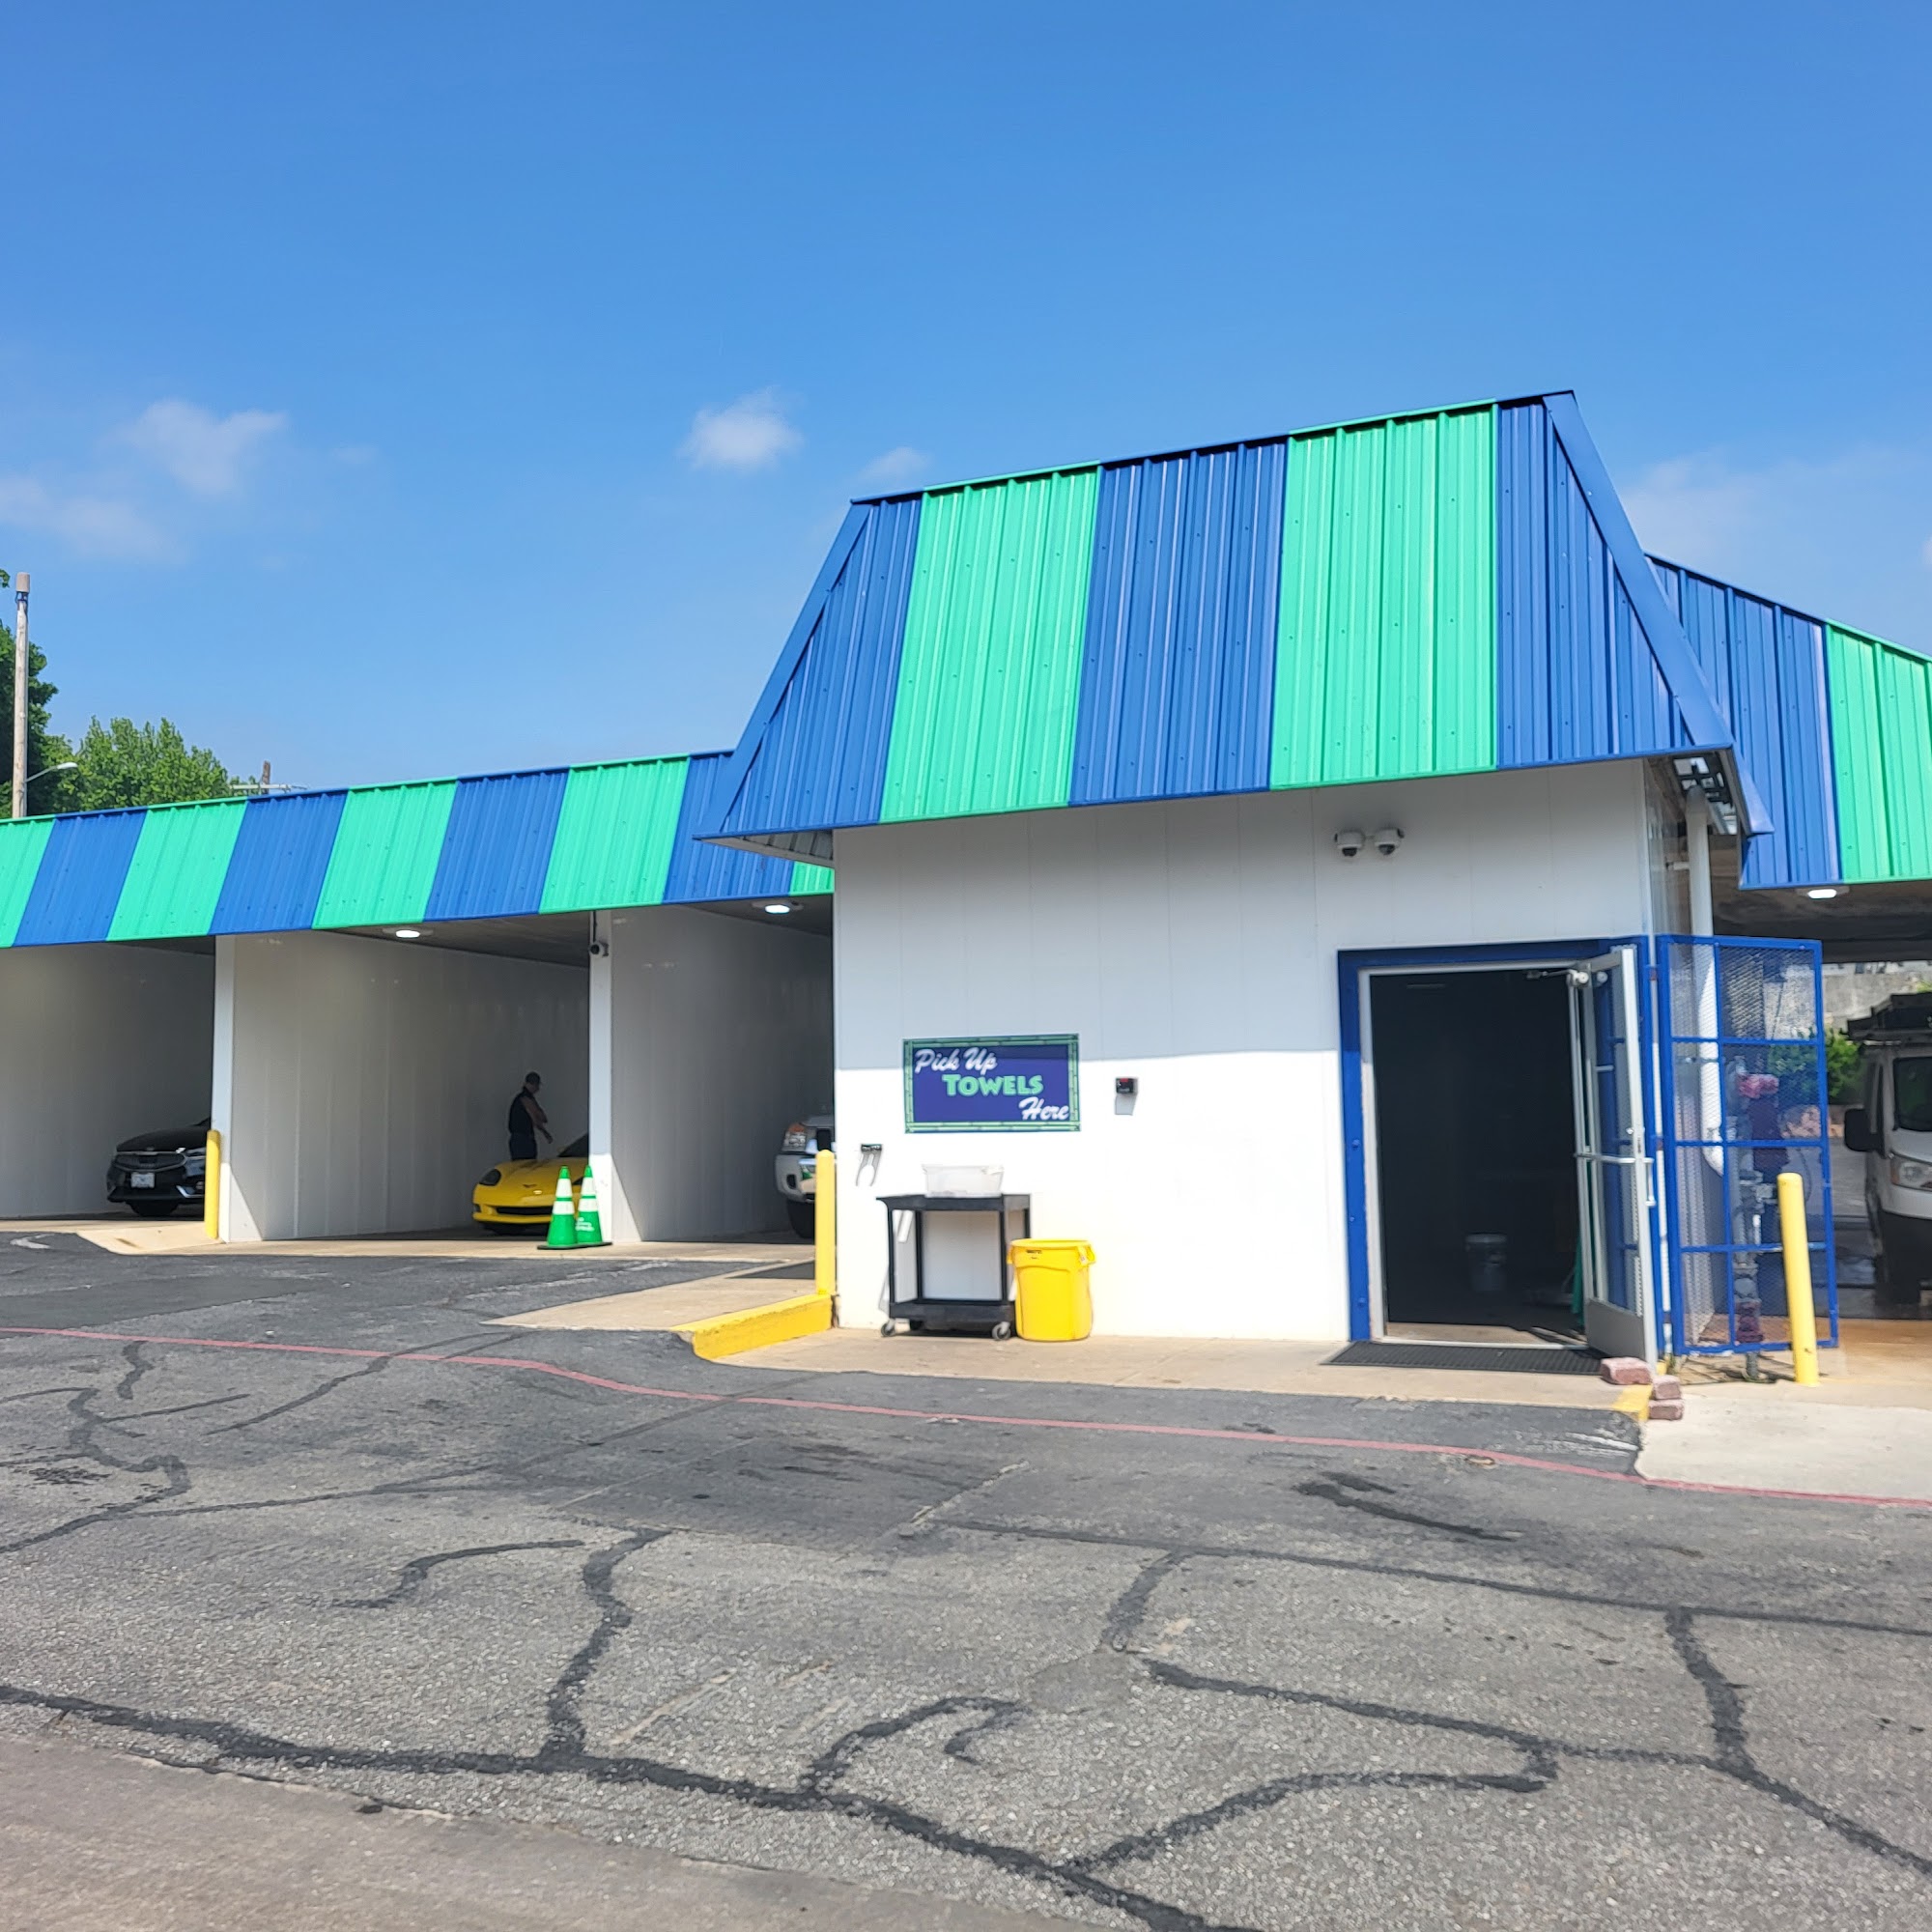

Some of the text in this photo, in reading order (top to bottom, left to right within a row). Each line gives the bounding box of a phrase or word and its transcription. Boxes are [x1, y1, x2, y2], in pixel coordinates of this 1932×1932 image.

[914, 1047, 998, 1075] Pick Up
[942, 1073, 1044, 1096] TOWELS
[1018, 1096, 1069, 1121] Here
